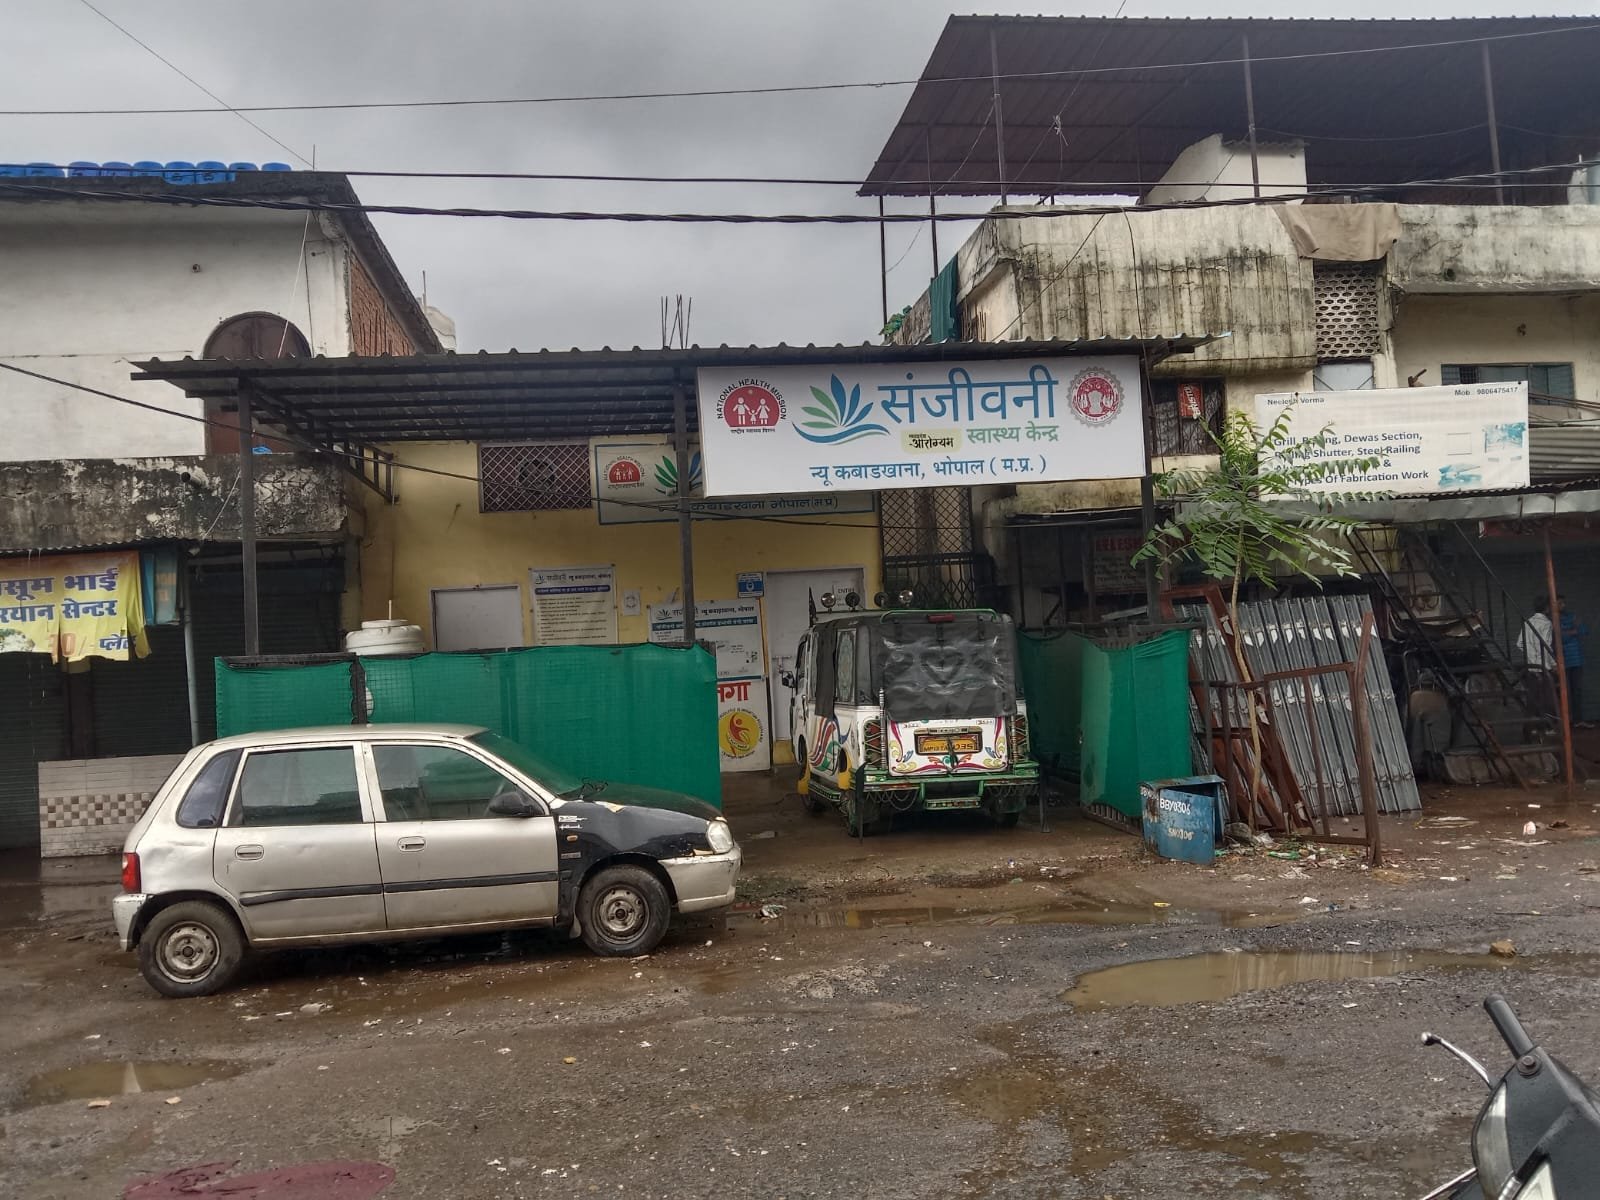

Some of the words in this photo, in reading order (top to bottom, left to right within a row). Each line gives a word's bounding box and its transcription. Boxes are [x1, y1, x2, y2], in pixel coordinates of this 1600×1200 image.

[738, 378, 770, 390] HEALTH
[878, 364, 1058, 424] संजीवनी
[966, 425, 1020, 444] स्वास्थ्य
[1026, 422, 1059, 443] केन्द्र
[1344, 434, 1379, 443] Dewas
[1381, 432, 1422, 441] Section,
[1386, 445, 1421, 455] Railing
[810, 464, 833, 486] न्यू
[933, 456, 985, 475] भोपाल
[1325, 475, 1339, 484] Of
[1401, 470, 1429, 480] Work
[64, 567, 118, 591] भाई
[0, 604, 55, 623] रयान
